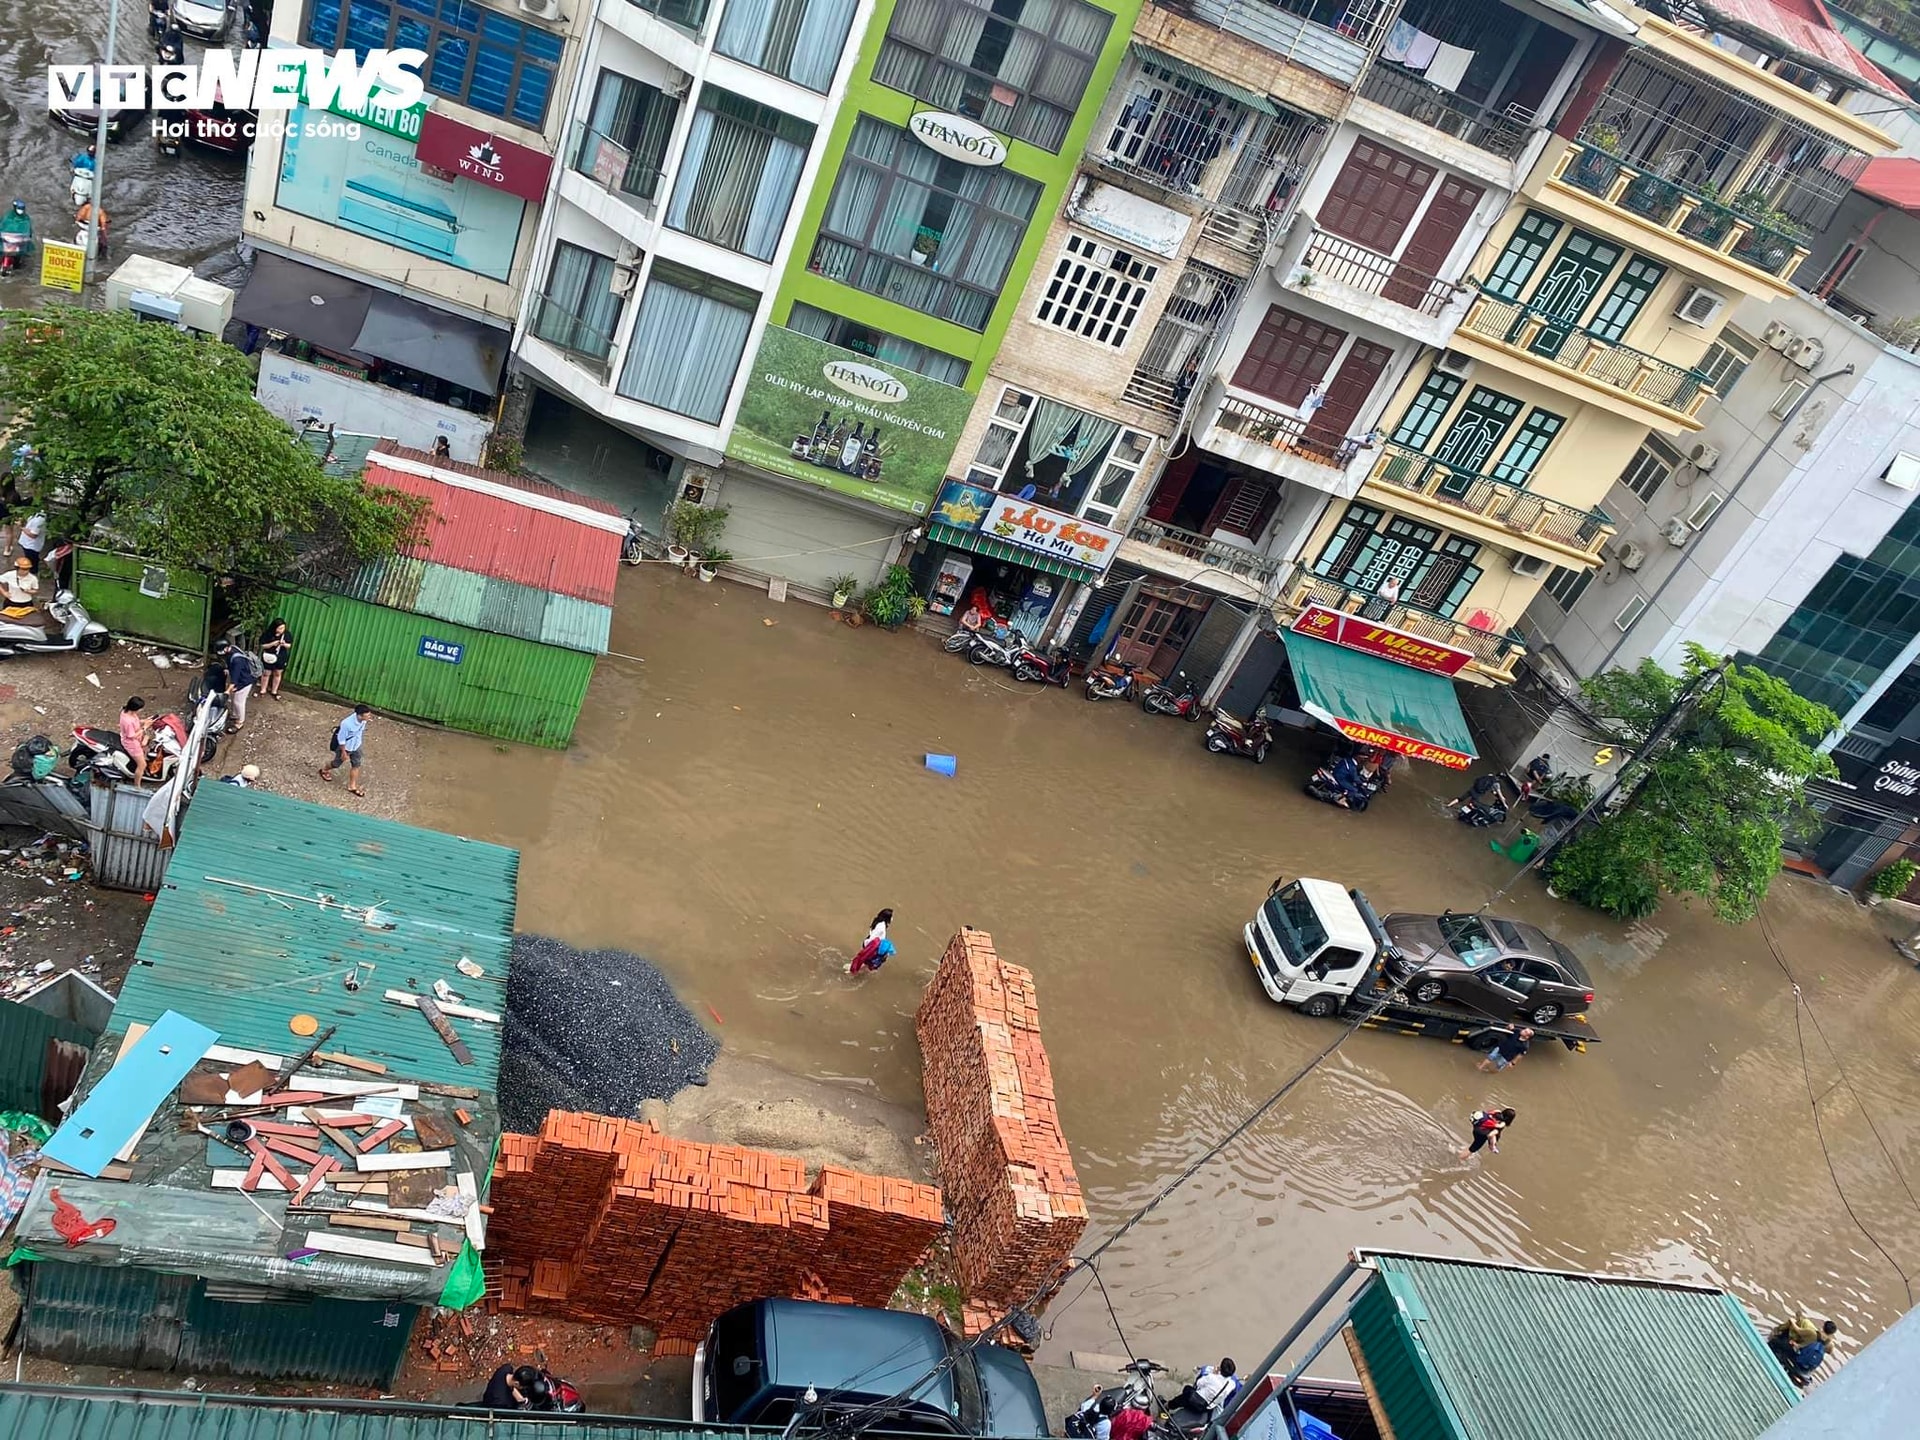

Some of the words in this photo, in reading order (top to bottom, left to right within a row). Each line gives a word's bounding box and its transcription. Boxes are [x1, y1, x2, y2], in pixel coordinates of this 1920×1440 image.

[398, 108, 421, 137] BÒ
[918, 117, 997, 160] HANOLI
[365, 140, 418, 169] Canada
[458, 158, 505, 183] WIND
[48, 255, 77, 270] HOUSE
[829, 364, 902, 399] HANOLI
[764, 373, 789, 388] OLIU
[790, 382, 803, 393] HY
[805, 386, 825, 400] LẠP
[922, 425, 947, 440] CHAI
[1000, 506, 1057, 534] LẨU
[1056, 522, 1110, 552] ẾCH
[1022, 529, 1046, 545] Hà
[424, 640, 445, 652] BẢO
[1379, 630, 1453, 663] Mart
[1342, 723, 1391, 745] HÀNG
[1395, 739, 1419, 753] TỰ
[1422, 747, 1469, 768] CHỌN
